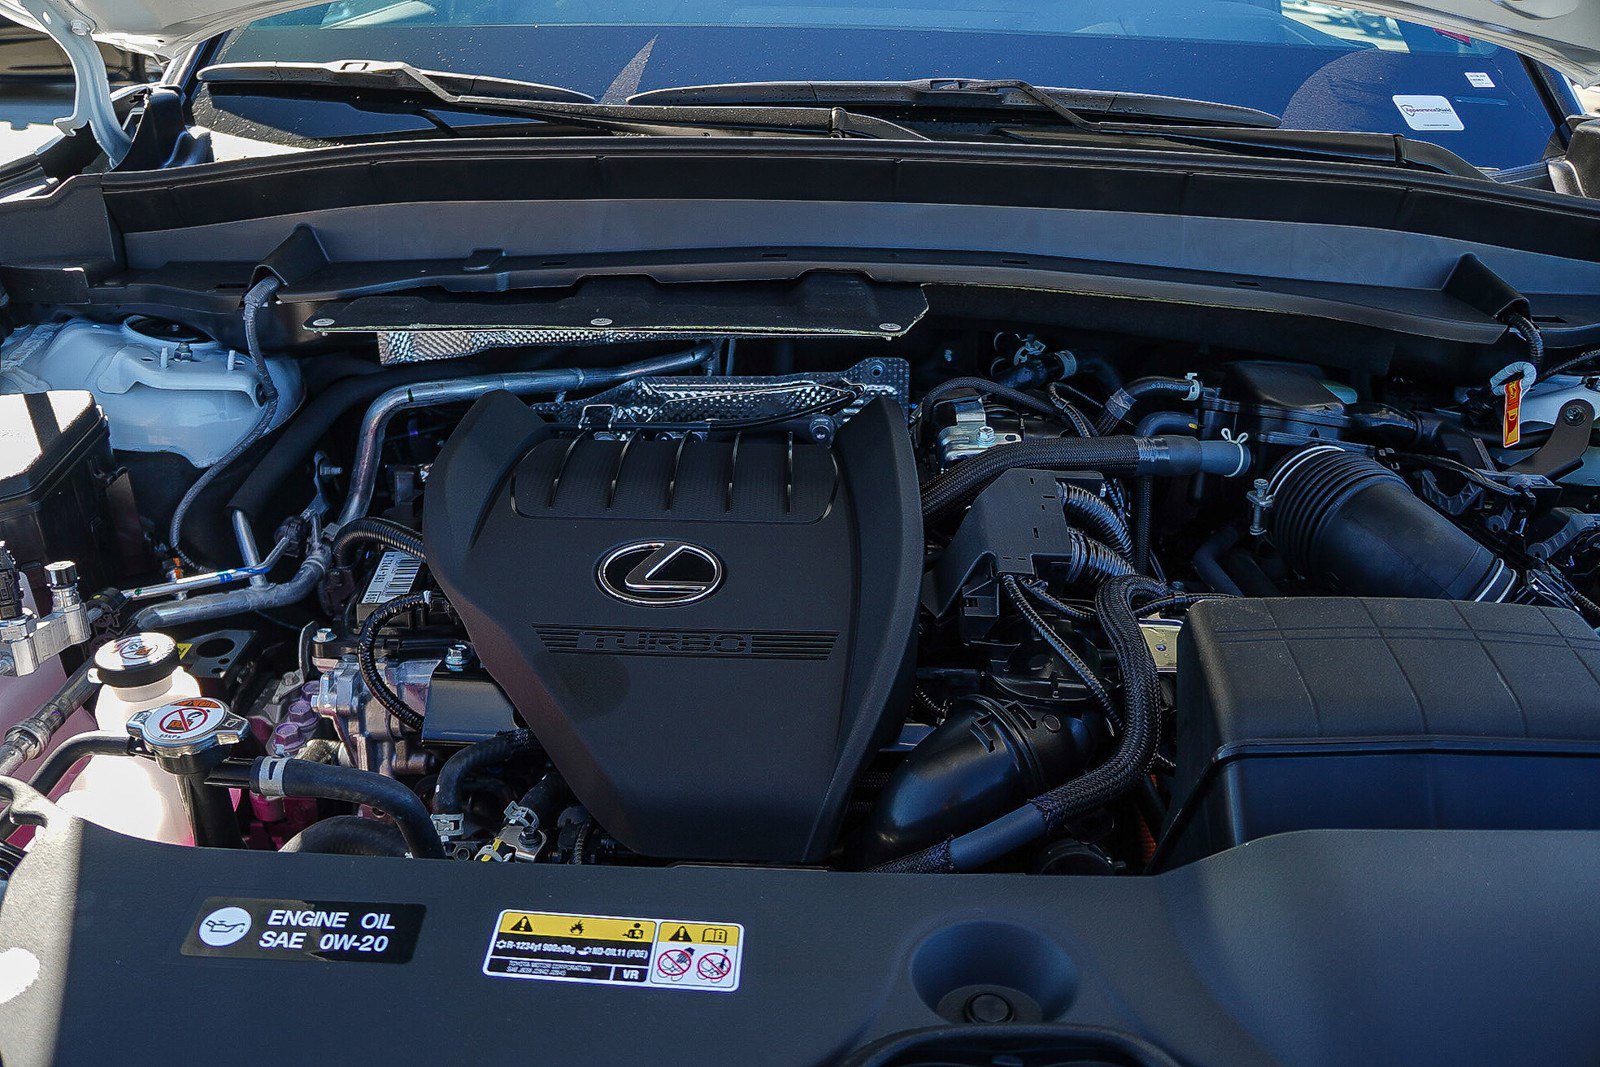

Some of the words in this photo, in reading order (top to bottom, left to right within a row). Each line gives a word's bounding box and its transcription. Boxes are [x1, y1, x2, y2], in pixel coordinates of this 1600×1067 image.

[579, 631, 748, 653] TURBO
[267, 909, 350, 928] ENGINE
[360, 912, 396, 930] OIL
[258, 931, 307, 949] SAE
[319, 934, 389, 953] 0W-20
[622, 969, 640, 980] VR
